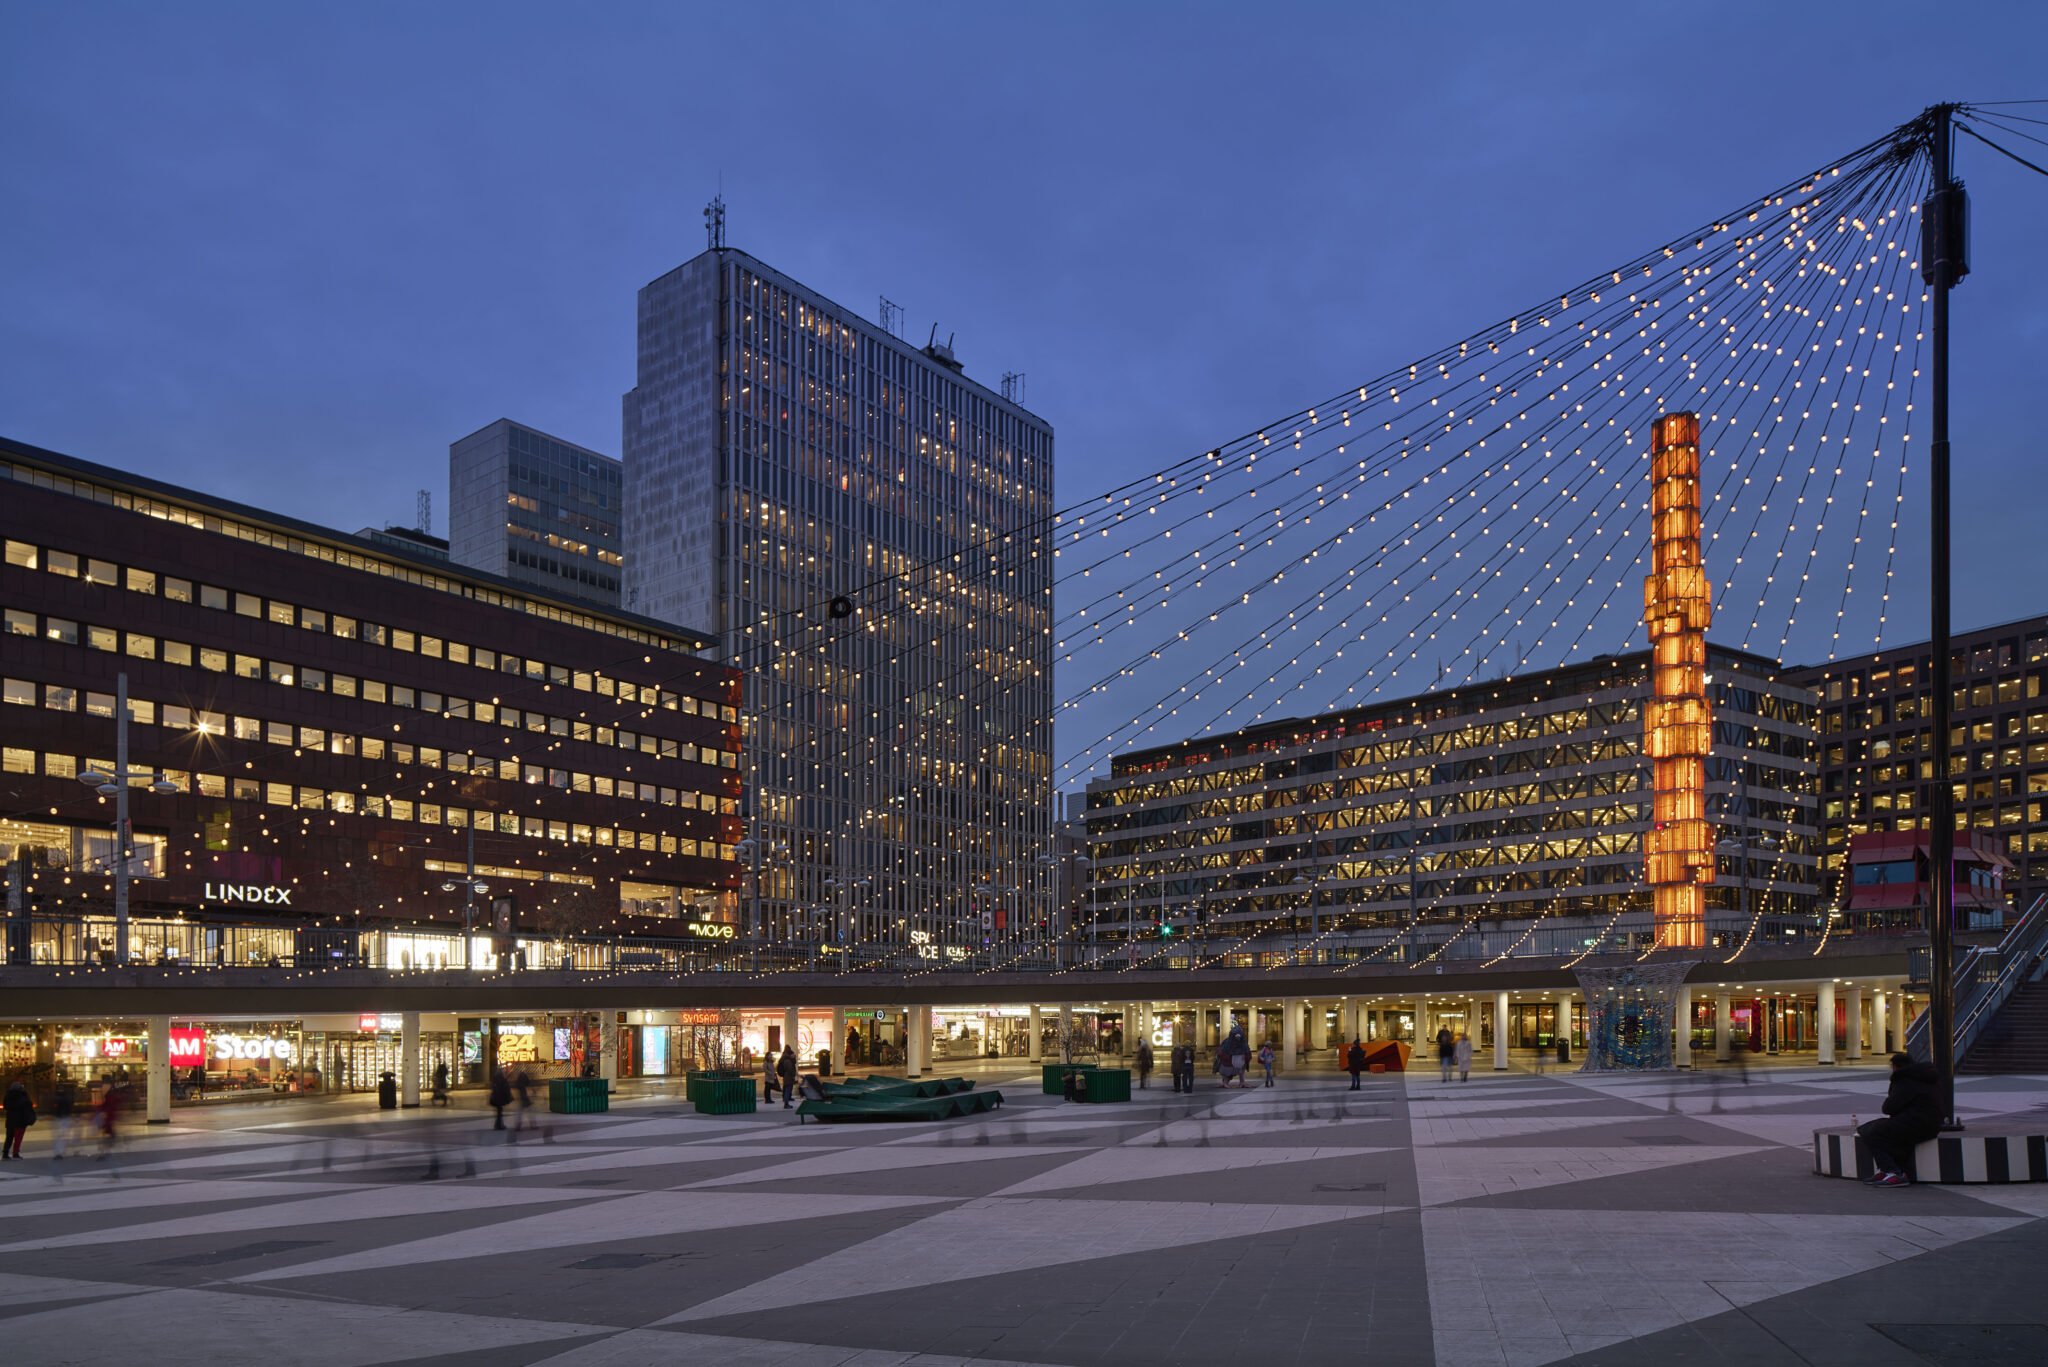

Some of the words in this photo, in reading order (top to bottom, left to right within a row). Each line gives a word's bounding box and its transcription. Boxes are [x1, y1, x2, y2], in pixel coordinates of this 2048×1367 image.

[205, 883, 291, 904] LINDEX
[380, 1017, 402, 1029] Stor
[216, 1034, 291, 1059] Store
[499, 1034, 536, 1051] 24
